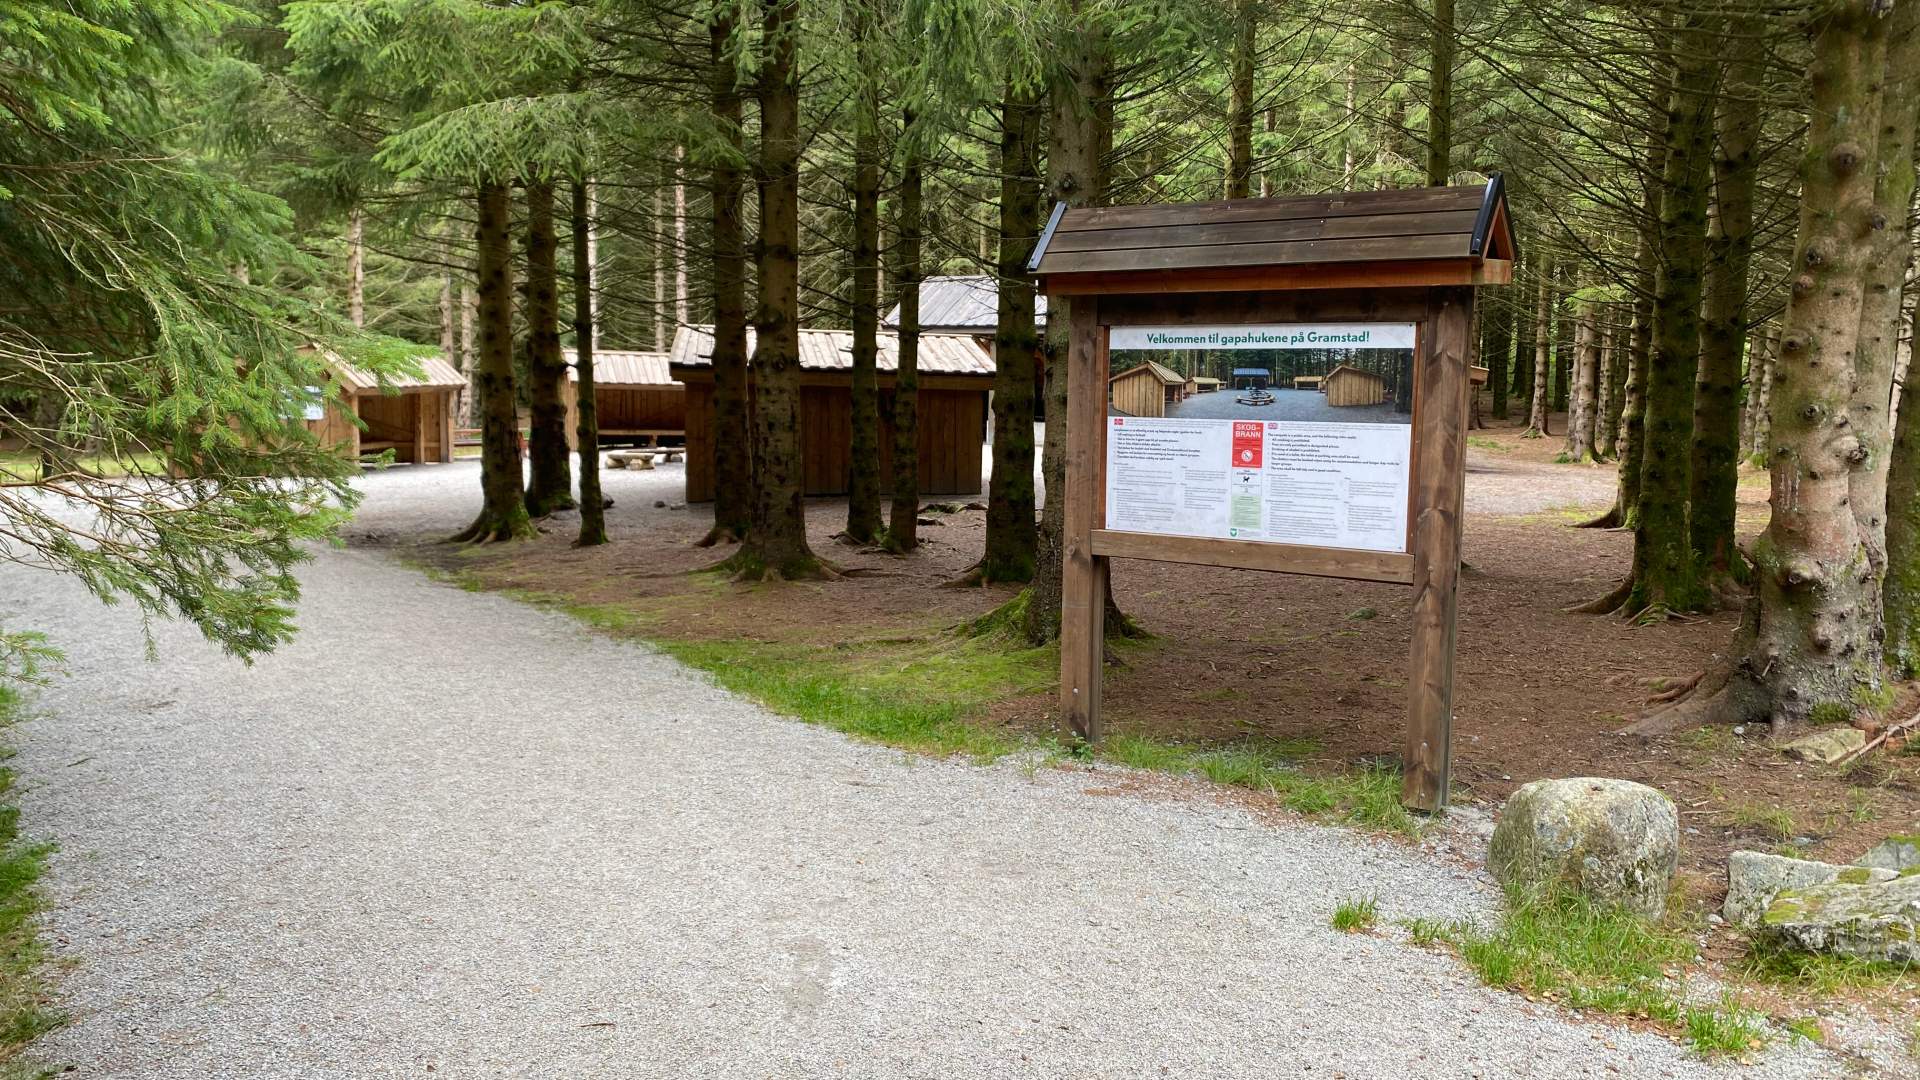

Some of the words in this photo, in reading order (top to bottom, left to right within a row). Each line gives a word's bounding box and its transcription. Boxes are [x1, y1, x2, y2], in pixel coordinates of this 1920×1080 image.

[1147, 333, 1206, 344] Velkommen
[1208, 332, 1219, 343] til
[1221, 332, 1288, 346] gapahukene
[1291, 331, 1305, 345] på
[1307, 331, 1370, 343] Gramstad!
